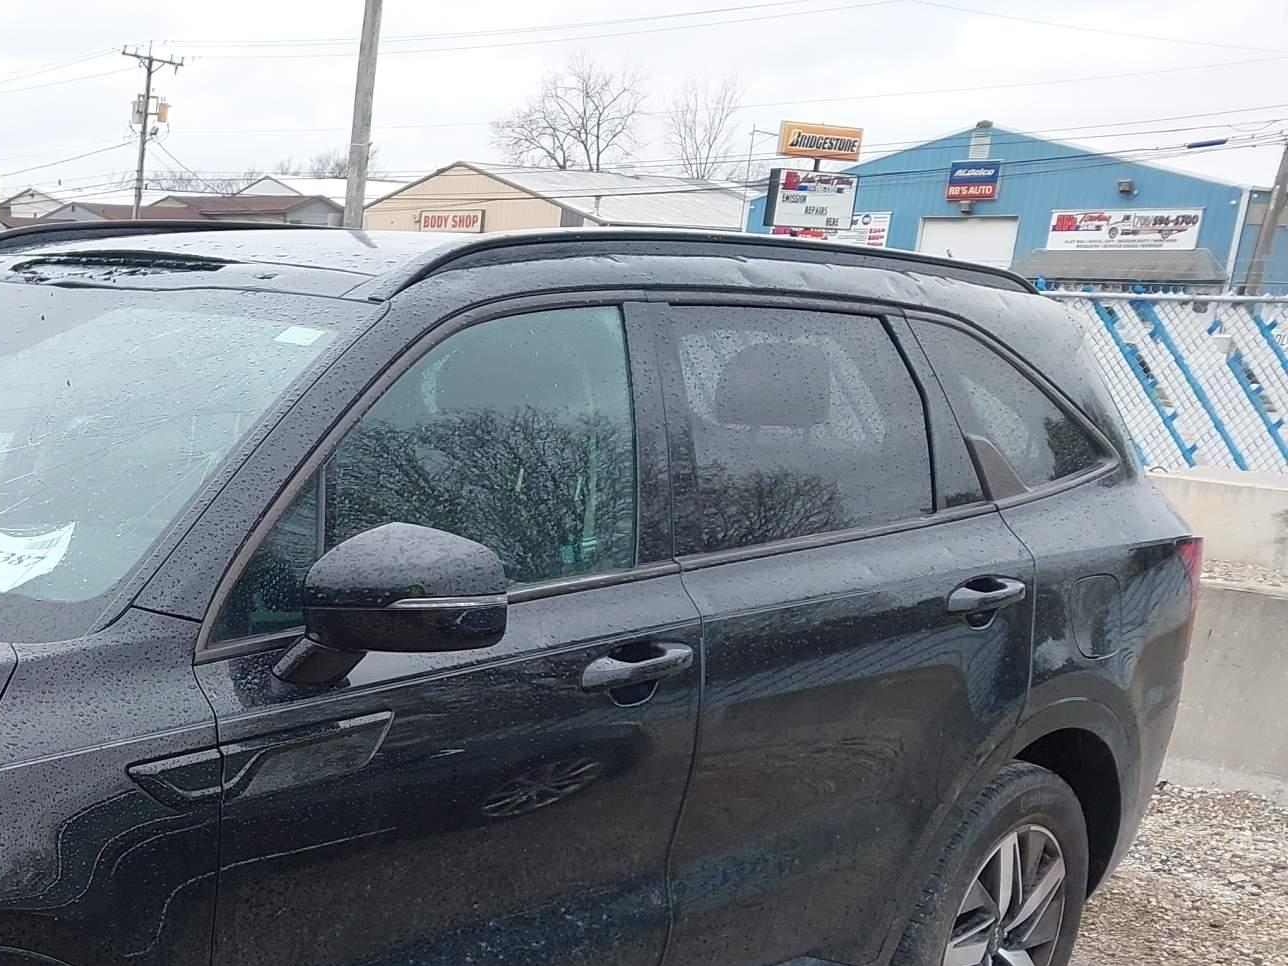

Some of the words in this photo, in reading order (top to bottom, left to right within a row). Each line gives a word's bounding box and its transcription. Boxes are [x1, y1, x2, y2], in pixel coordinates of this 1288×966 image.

[789, 131, 858, 152] BRIDGESTONE
[968, 185, 993, 195] AUTO
[781, 194, 807, 204] EMISSION
[804, 205, 829, 216] REPAIRS
[423, 215, 450, 228] BODY
[452, 214, 479, 228] SHOP
[825, 217, 840, 226] HERE
